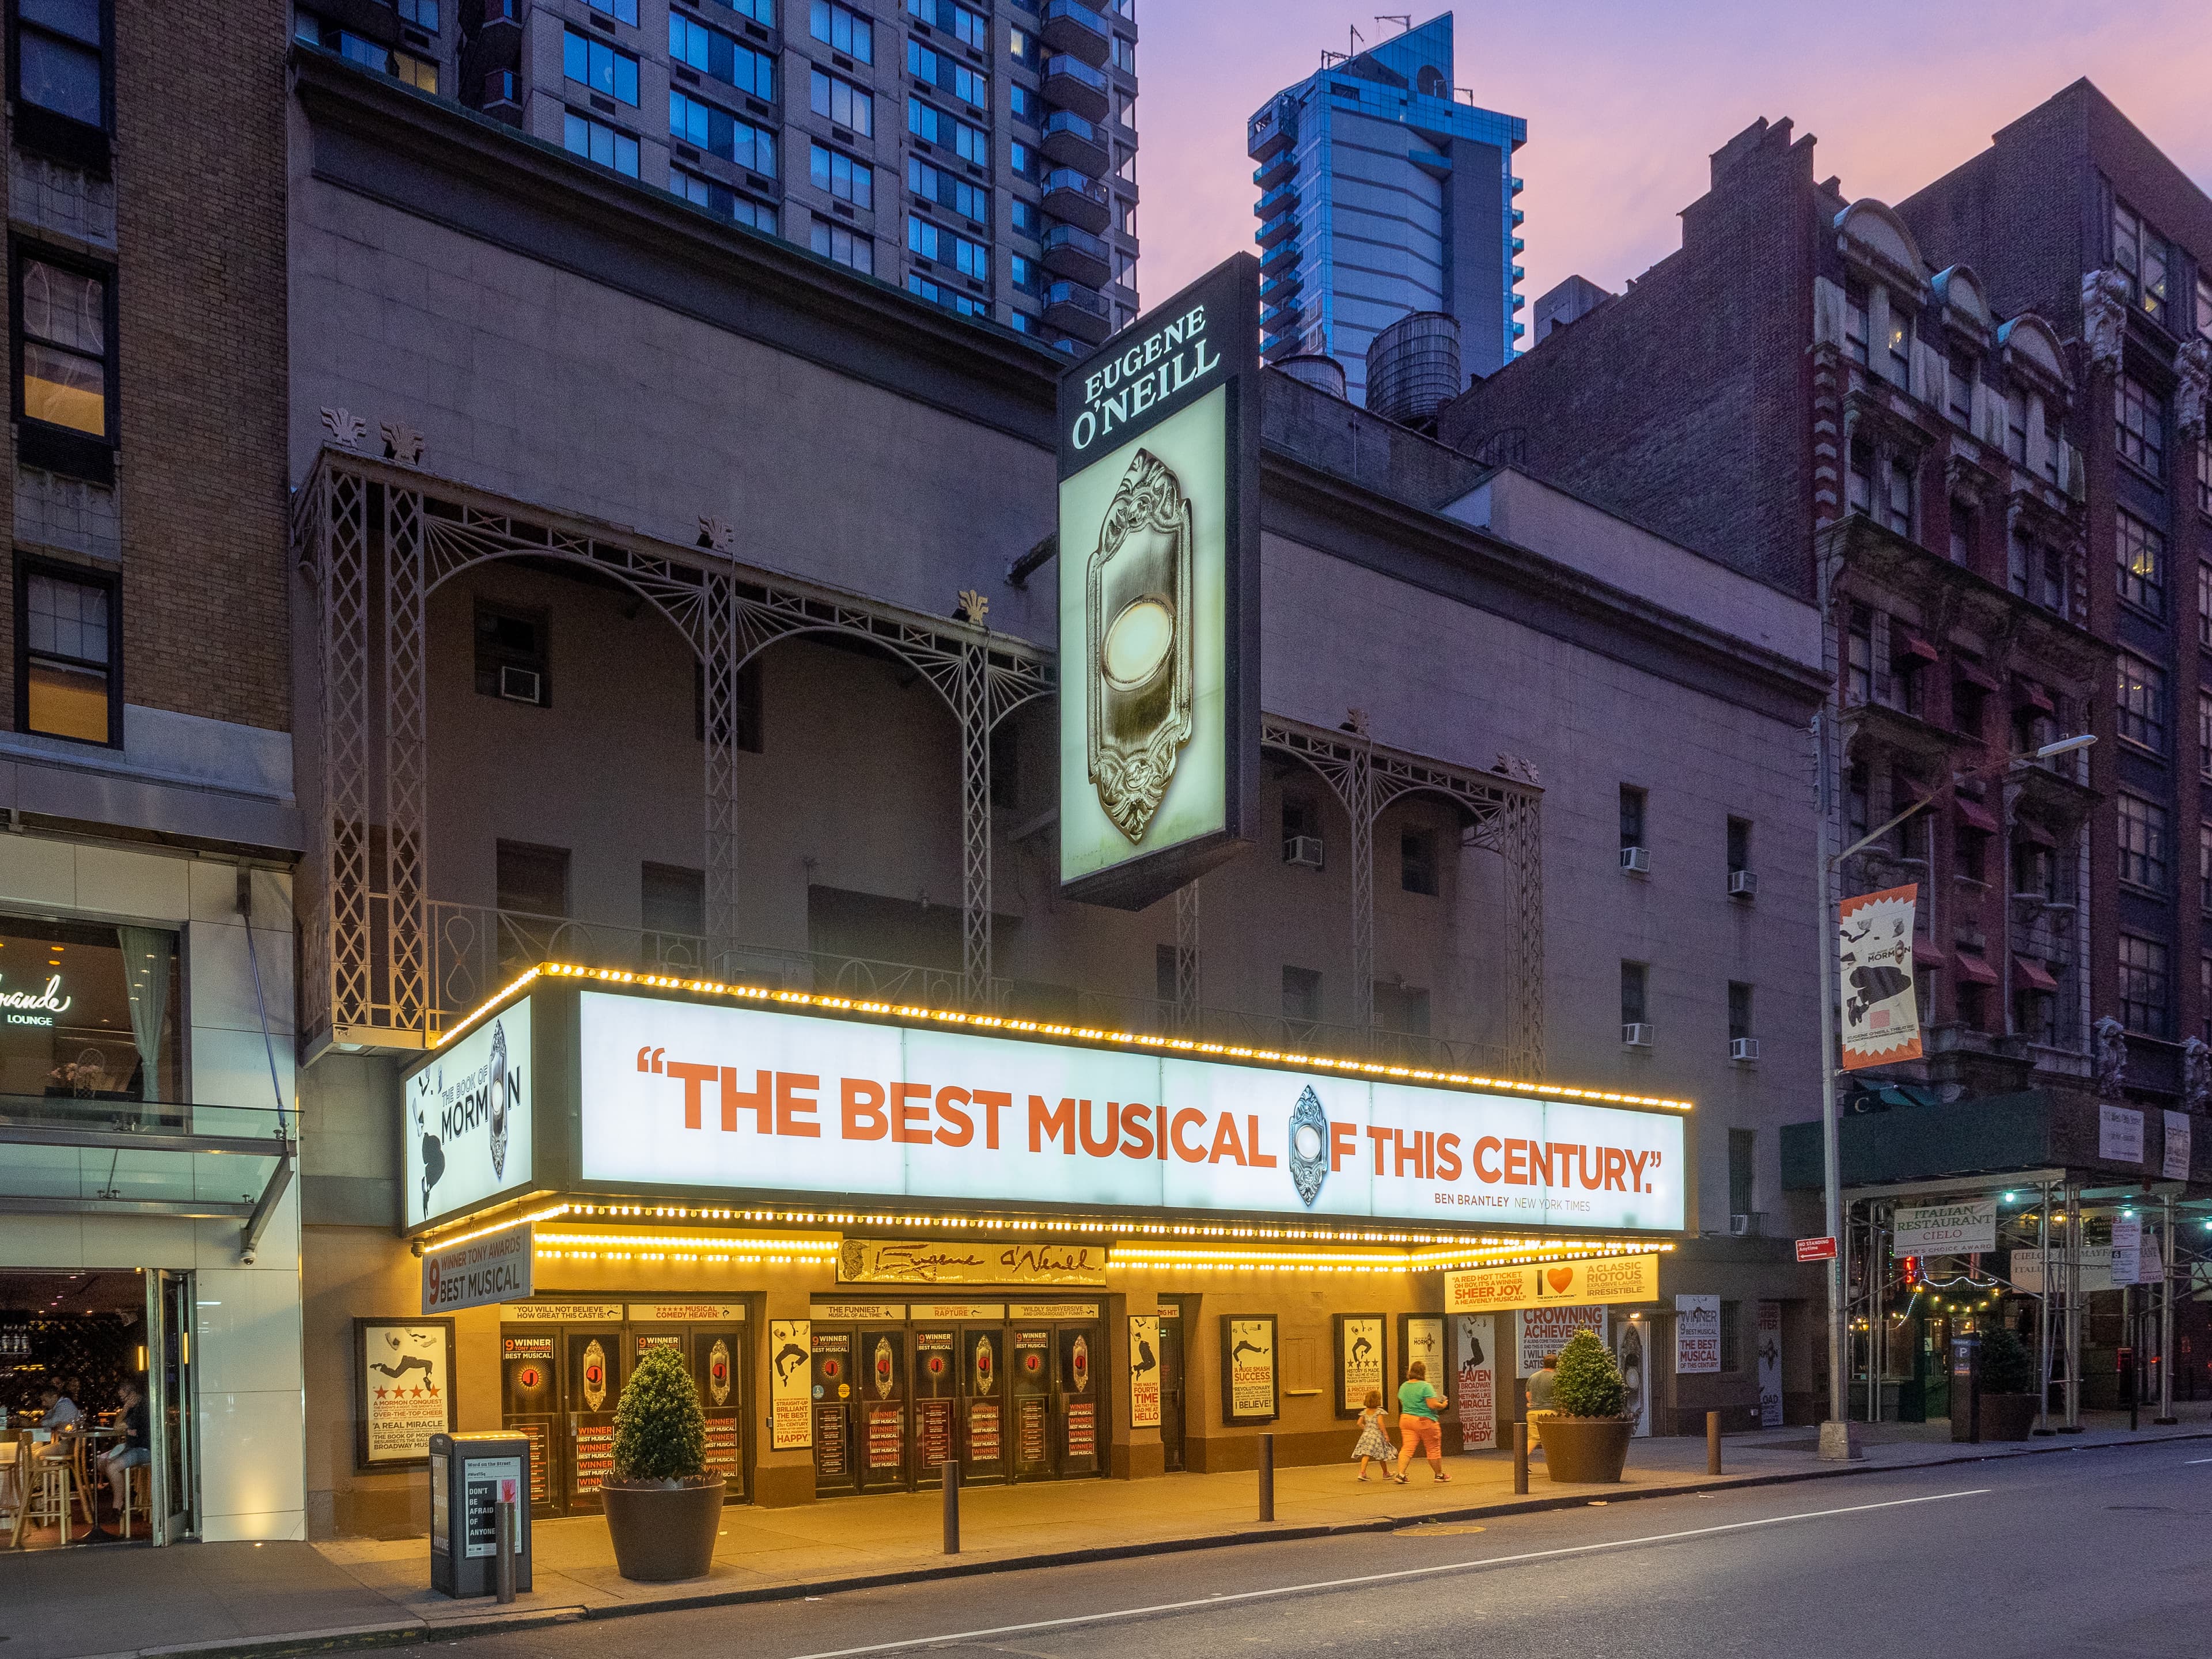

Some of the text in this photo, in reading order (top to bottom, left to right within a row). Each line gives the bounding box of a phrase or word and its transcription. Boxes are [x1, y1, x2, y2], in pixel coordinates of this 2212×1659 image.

[1085, 305, 1206, 404] EUGENE
[1072, 339, 1220, 450] O'NEILL
[0, 974, 71, 1012] rande
[7, 1014, 53, 1026] LOUNGE
[442, 1065, 489, 1107] THE BOOK OF
[840, 1077, 1012, 1150] BEST
[1028, 1094, 1277, 1169] MUSICAL
[1366, 1125, 1461, 1181] THIS
[1434, 1193, 1591, 1212] BEN BRANTLEY NEW YORK TIMES
[1914, 1206, 1974, 1219] ITALIAN
[1897, 1214, 1993, 1232] RESTAURANT
[1923, 1229, 1962, 1240] CIELO
[429, 1258, 440, 1305] 9
[441, 1251, 467, 1271] WINNER
[468, 1245, 487, 1265] TONY
[488, 1236, 521, 1259] AWARDS
[1596, 1262, 1643, 1273] CLASSIC.
[1494, 1271, 1523, 1279] TICKET.
[1587, 1270, 1643, 1283] RIOTOUS.
[440, 1263, 520, 1303] BEST MUSICAL
[1455, 1285, 1523, 1300] SHEER JOY.
[1524, 1307, 1602, 1324] CROWNING
[505, 1339, 514, 1351] 9
[1698, 1339, 1717, 1349] BEST
[1528, 1350, 1544, 1359] WILL
[1680, 1350, 1717, 1362] MUSICAL
[1960, 1348, 1967, 1357] P
[1234, 1372, 1271, 1381] SUCCESS.
[1134, 1393, 1158, 1404] TIME
[1134, 1412, 1159, 1421] HELLO
[578, 1426, 612, 1435] WINNER
[469, 1528, 495, 1536] ANYONE
